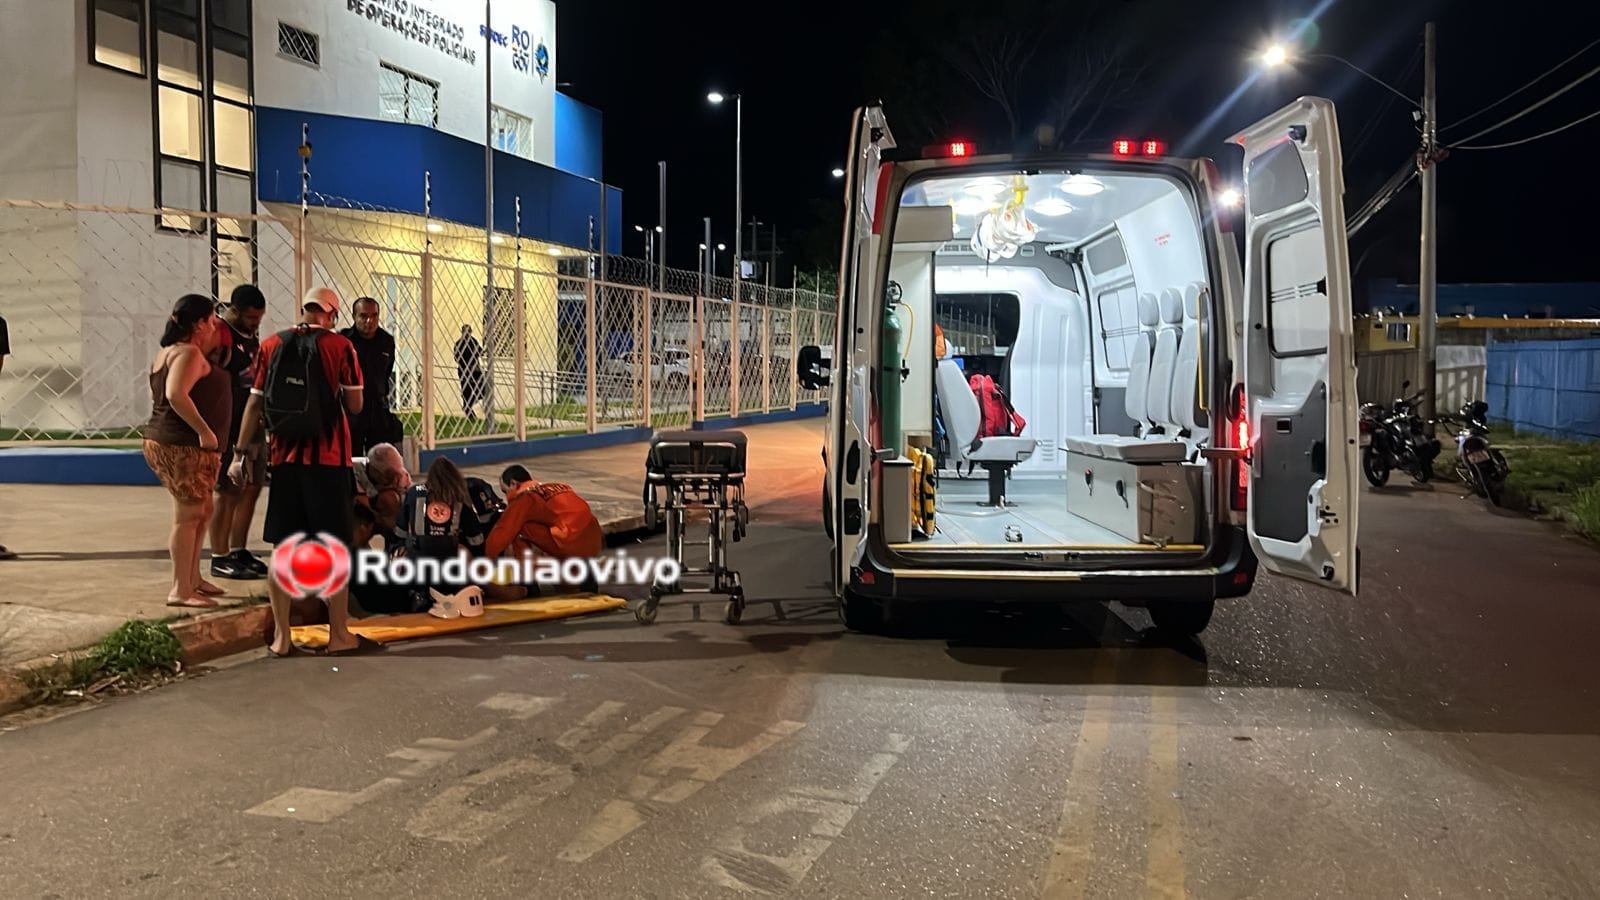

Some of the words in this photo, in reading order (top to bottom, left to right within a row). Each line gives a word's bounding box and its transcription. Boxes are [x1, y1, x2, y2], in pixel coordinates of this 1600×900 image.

[347, 0, 365, 15] DE
[433, 33, 476, 65] POLICIAIS
[410, 3, 464, 41] INTEGRADO
[512, 24, 530, 50] RO
